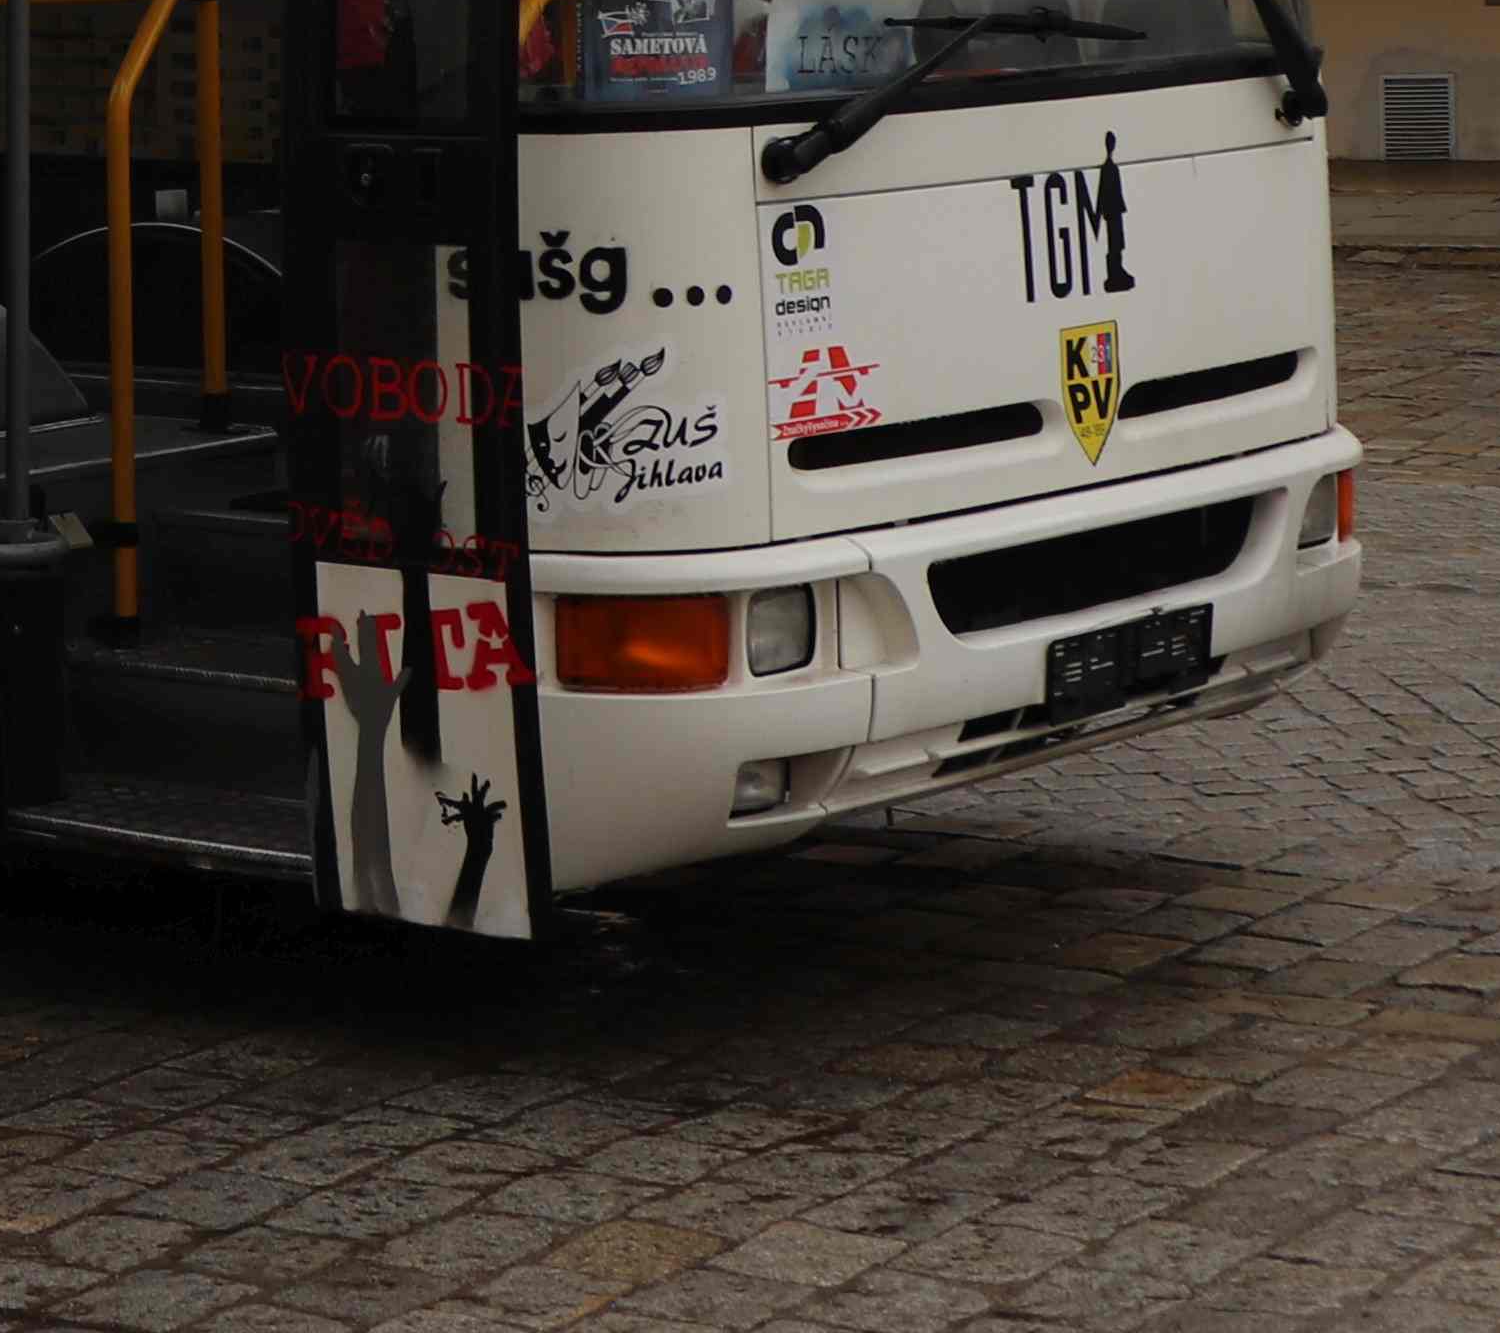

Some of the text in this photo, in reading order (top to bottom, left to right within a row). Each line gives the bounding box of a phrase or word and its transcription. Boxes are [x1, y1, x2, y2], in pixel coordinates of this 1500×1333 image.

[796, 23, 886, 75] LÁSK
[1009, 170, 1124, 304] TGM
[775, 293, 831, 317] design
[613, 457, 724, 504] Jihlava
